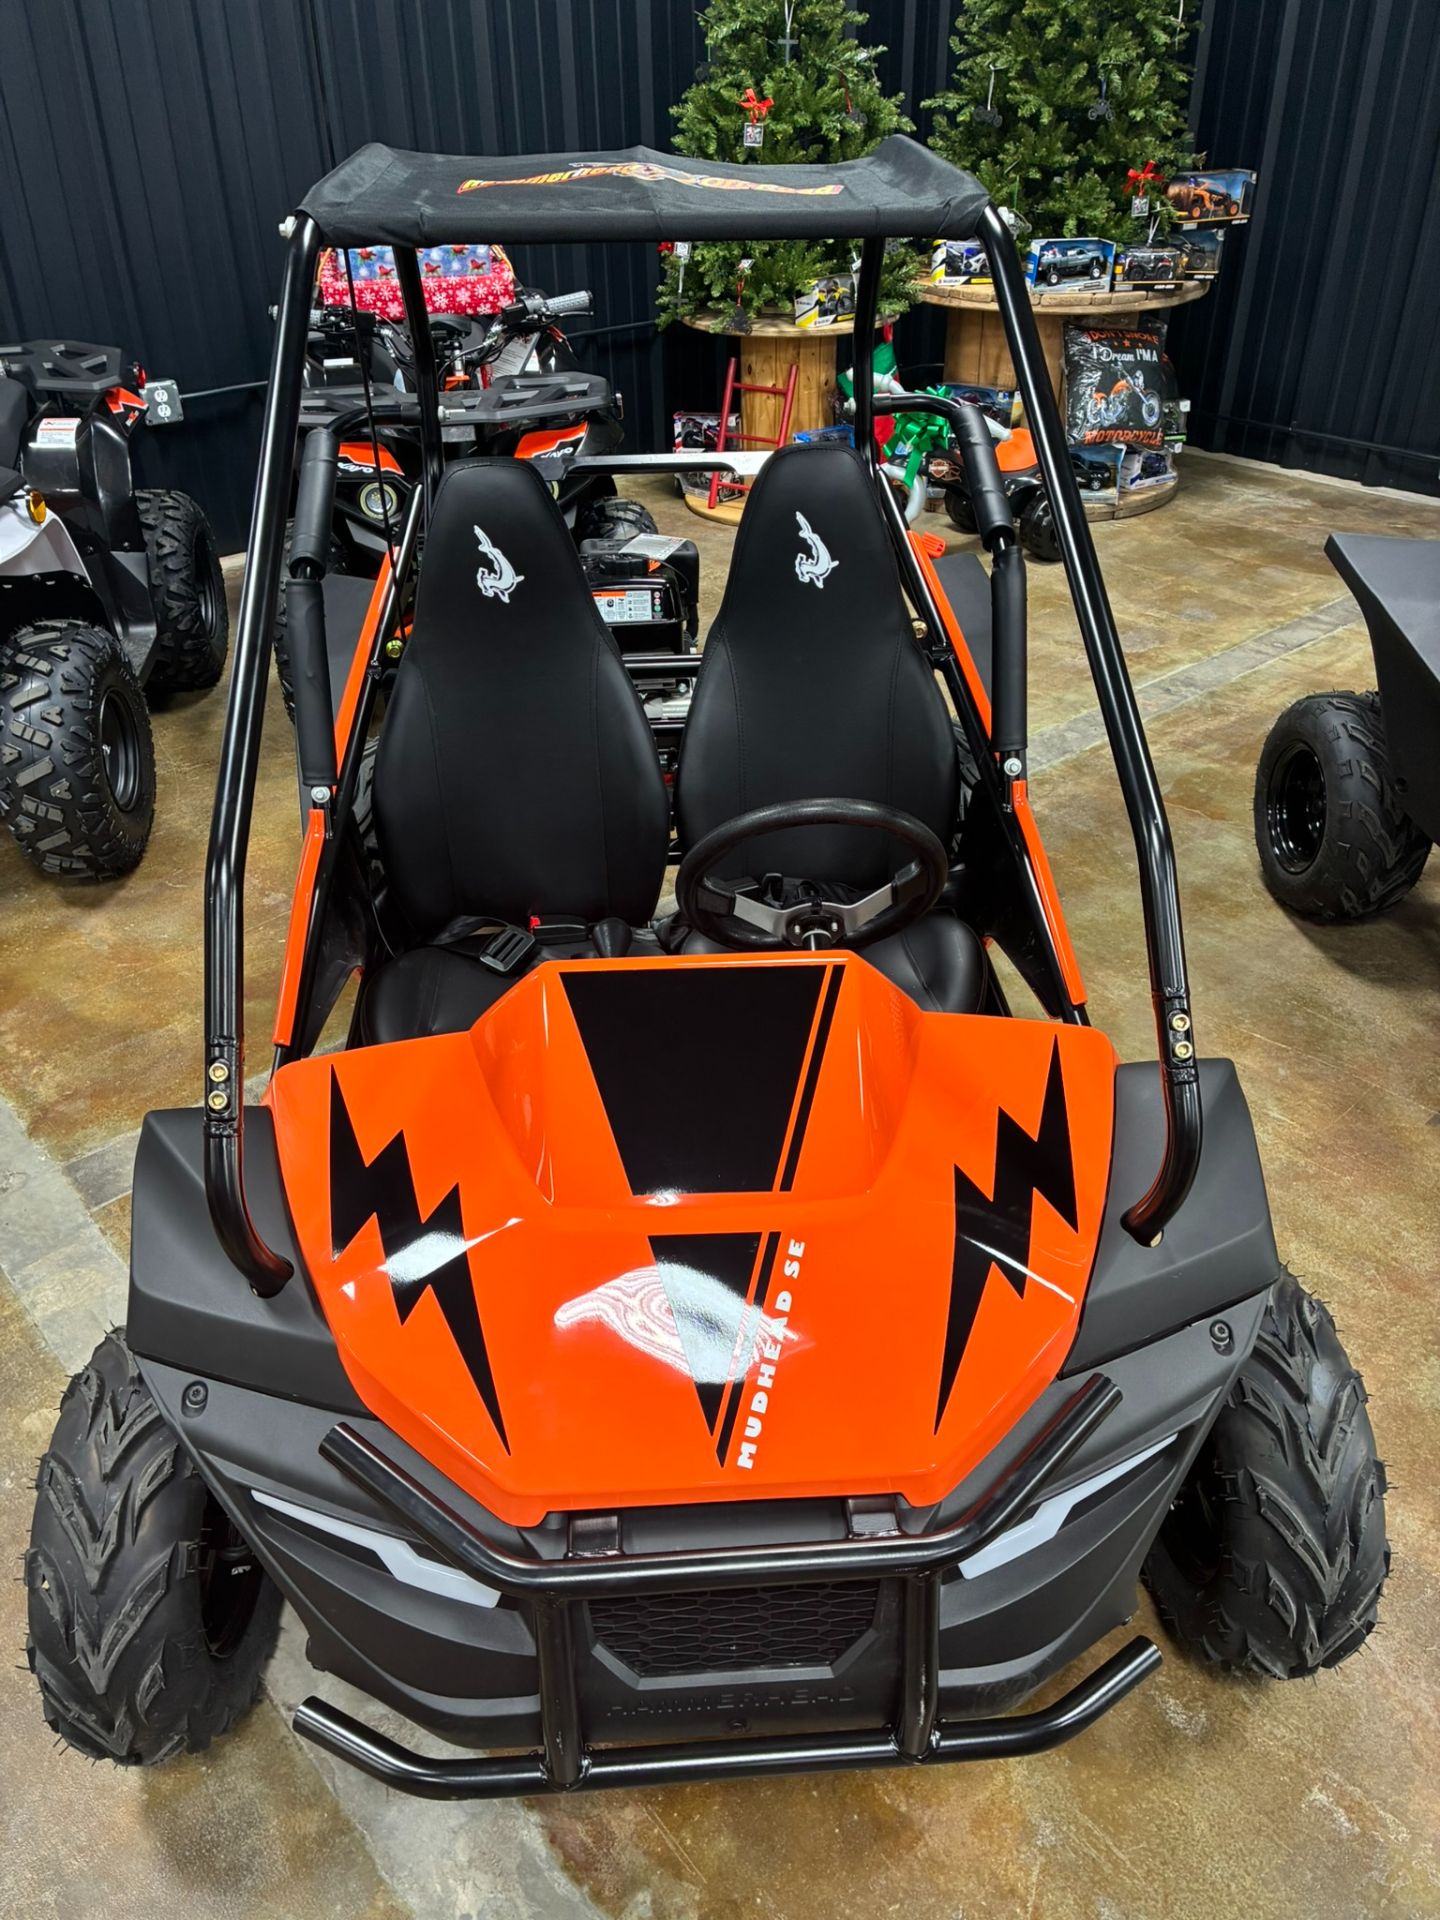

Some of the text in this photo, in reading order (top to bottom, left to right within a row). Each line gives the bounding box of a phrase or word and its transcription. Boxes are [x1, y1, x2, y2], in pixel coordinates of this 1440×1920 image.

[1098, 345, 1135, 361] Dream
[1084, 428, 1164, 446] MOTORCYCLE
[736, 1238, 806, 1470] MUDHEAD SE
